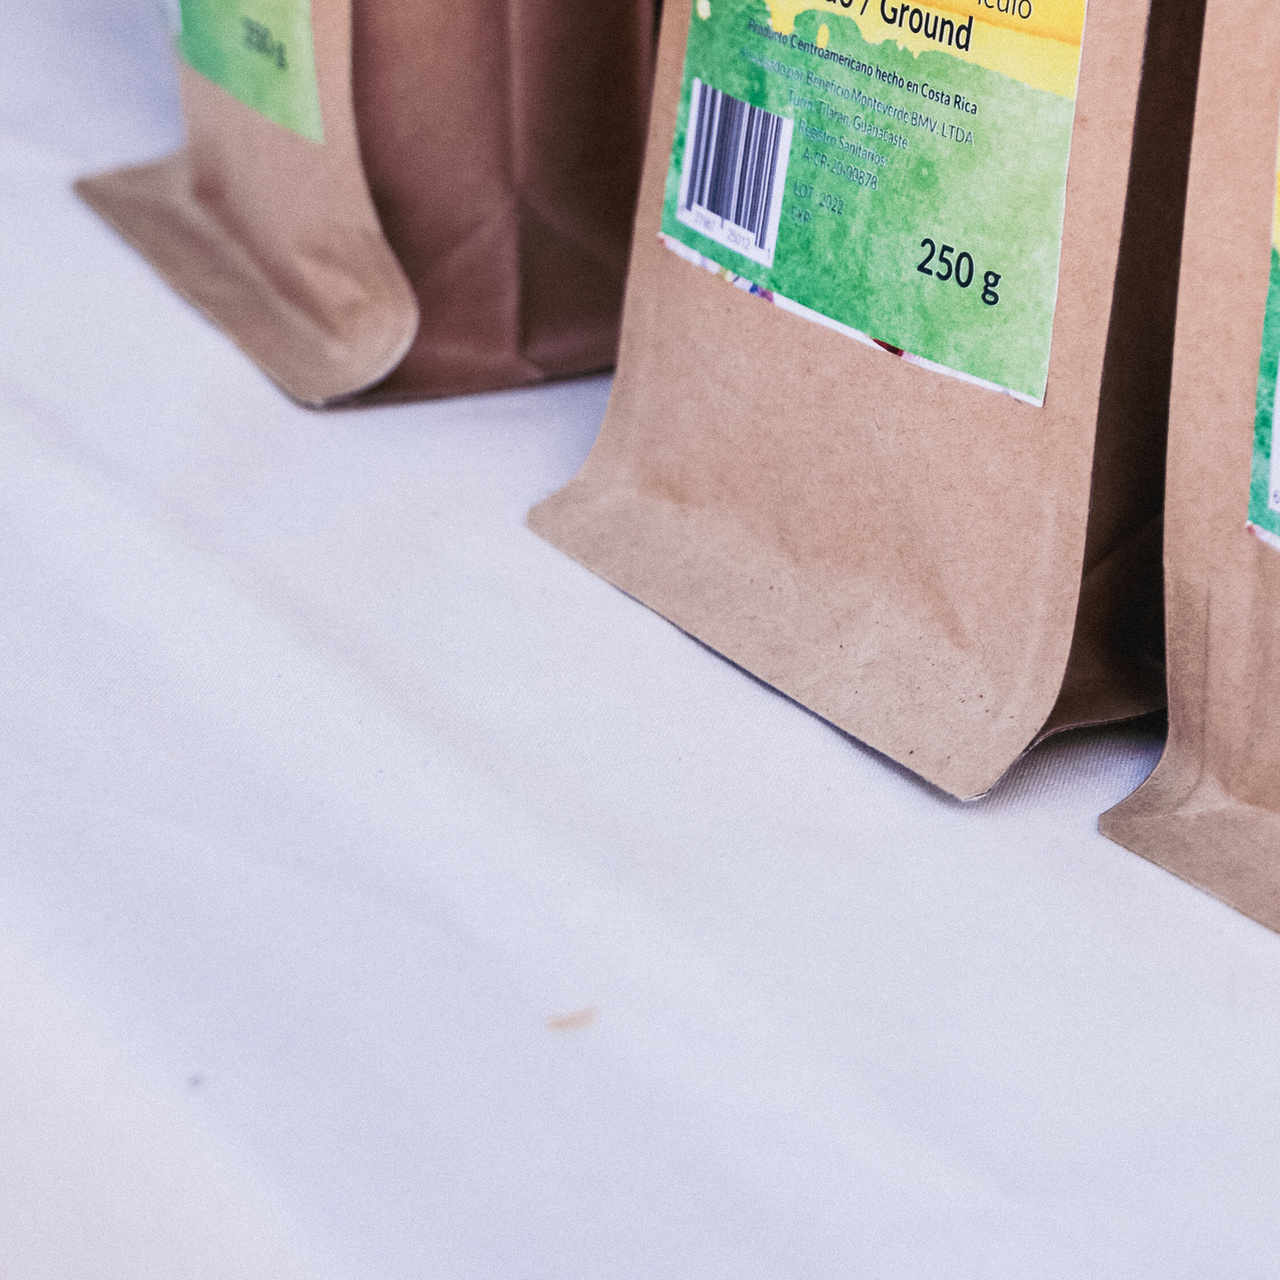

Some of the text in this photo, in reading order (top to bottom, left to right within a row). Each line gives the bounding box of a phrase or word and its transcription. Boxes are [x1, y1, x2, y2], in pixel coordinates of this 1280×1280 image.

[791, 33, 873, 77] Centroamericano
[876, 64, 905, 90] hecho
[906, 80, 919, 95] en
[921, 82, 951, 108] Costa
[953, 93, 978, 116] Rica
[851, 87, 909, 125] Monteverde
[941, 122, 975, 148] LTDA
[853, 115, 909, 150] Guanacaste
[916, 237, 1002, 307] 250 g
